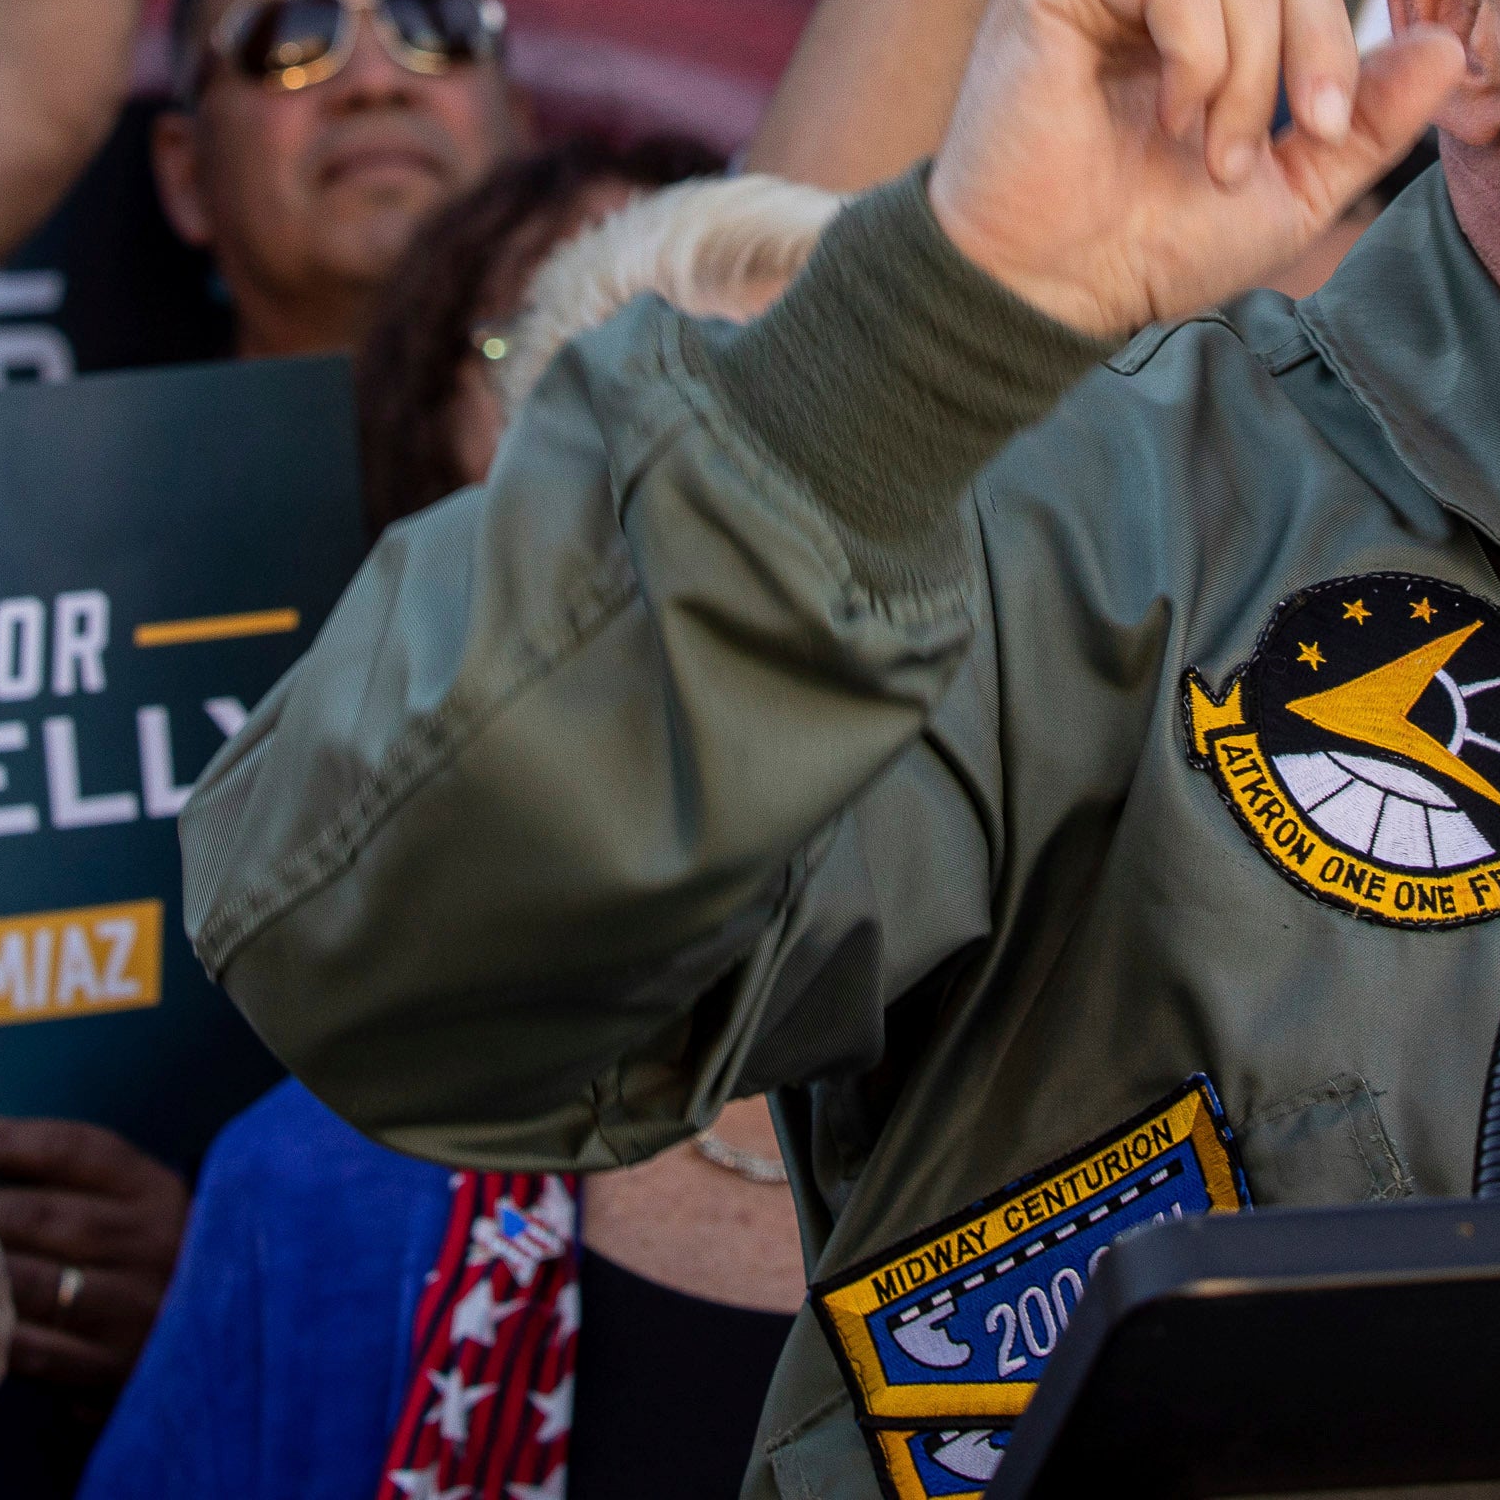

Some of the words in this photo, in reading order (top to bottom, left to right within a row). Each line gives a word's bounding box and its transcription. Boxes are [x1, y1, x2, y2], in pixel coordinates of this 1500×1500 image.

[1221, 744, 1316, 865] ATKRON
[1320, 856, 1387, 902] ONE
[1393, 881, 1457, 914] ONE
[870, 1220, 990, 1303] MIDWAY
[1003, 1117, 1174, 1234] CENTURION
